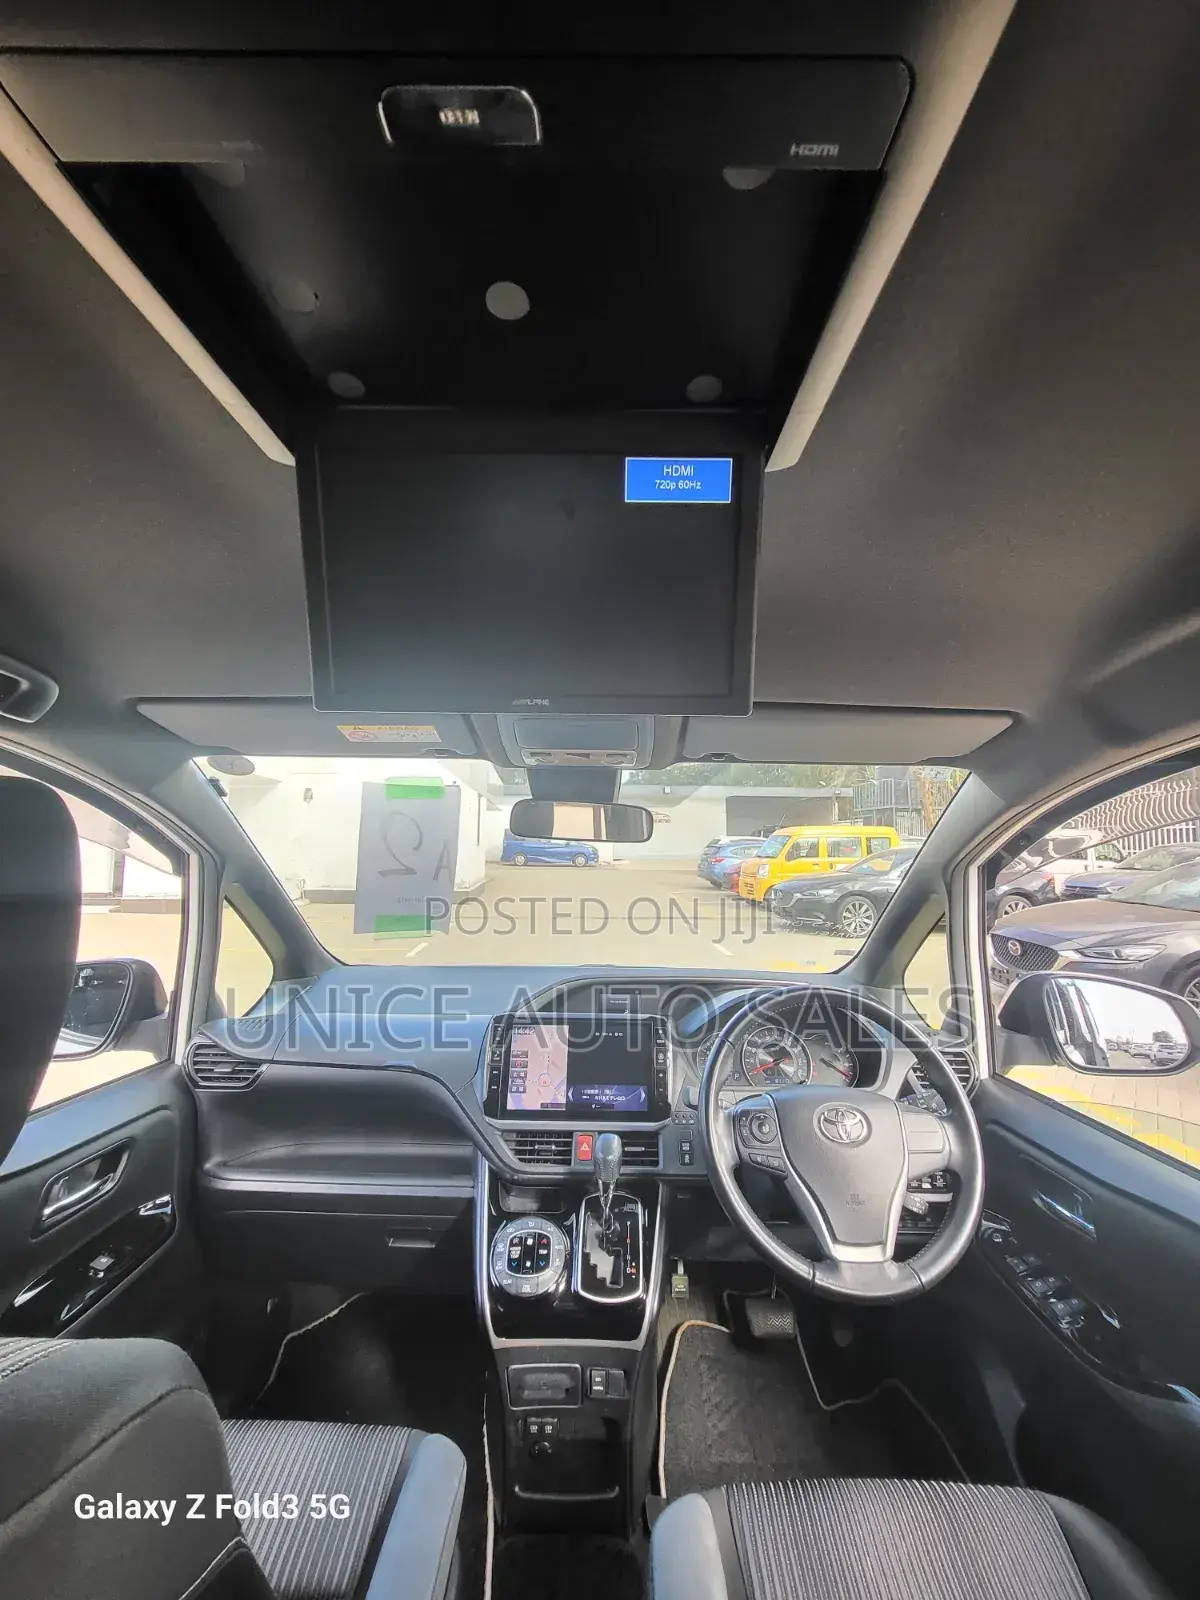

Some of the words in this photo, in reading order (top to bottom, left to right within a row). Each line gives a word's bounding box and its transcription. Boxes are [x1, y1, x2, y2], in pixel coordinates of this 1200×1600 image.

[789, 142, 840, 157] HDMI
[662, 464, 695, 477] HDMI
[654, 479, 677, 491] 720p
[678, 480, 702, 490] 60Hz
